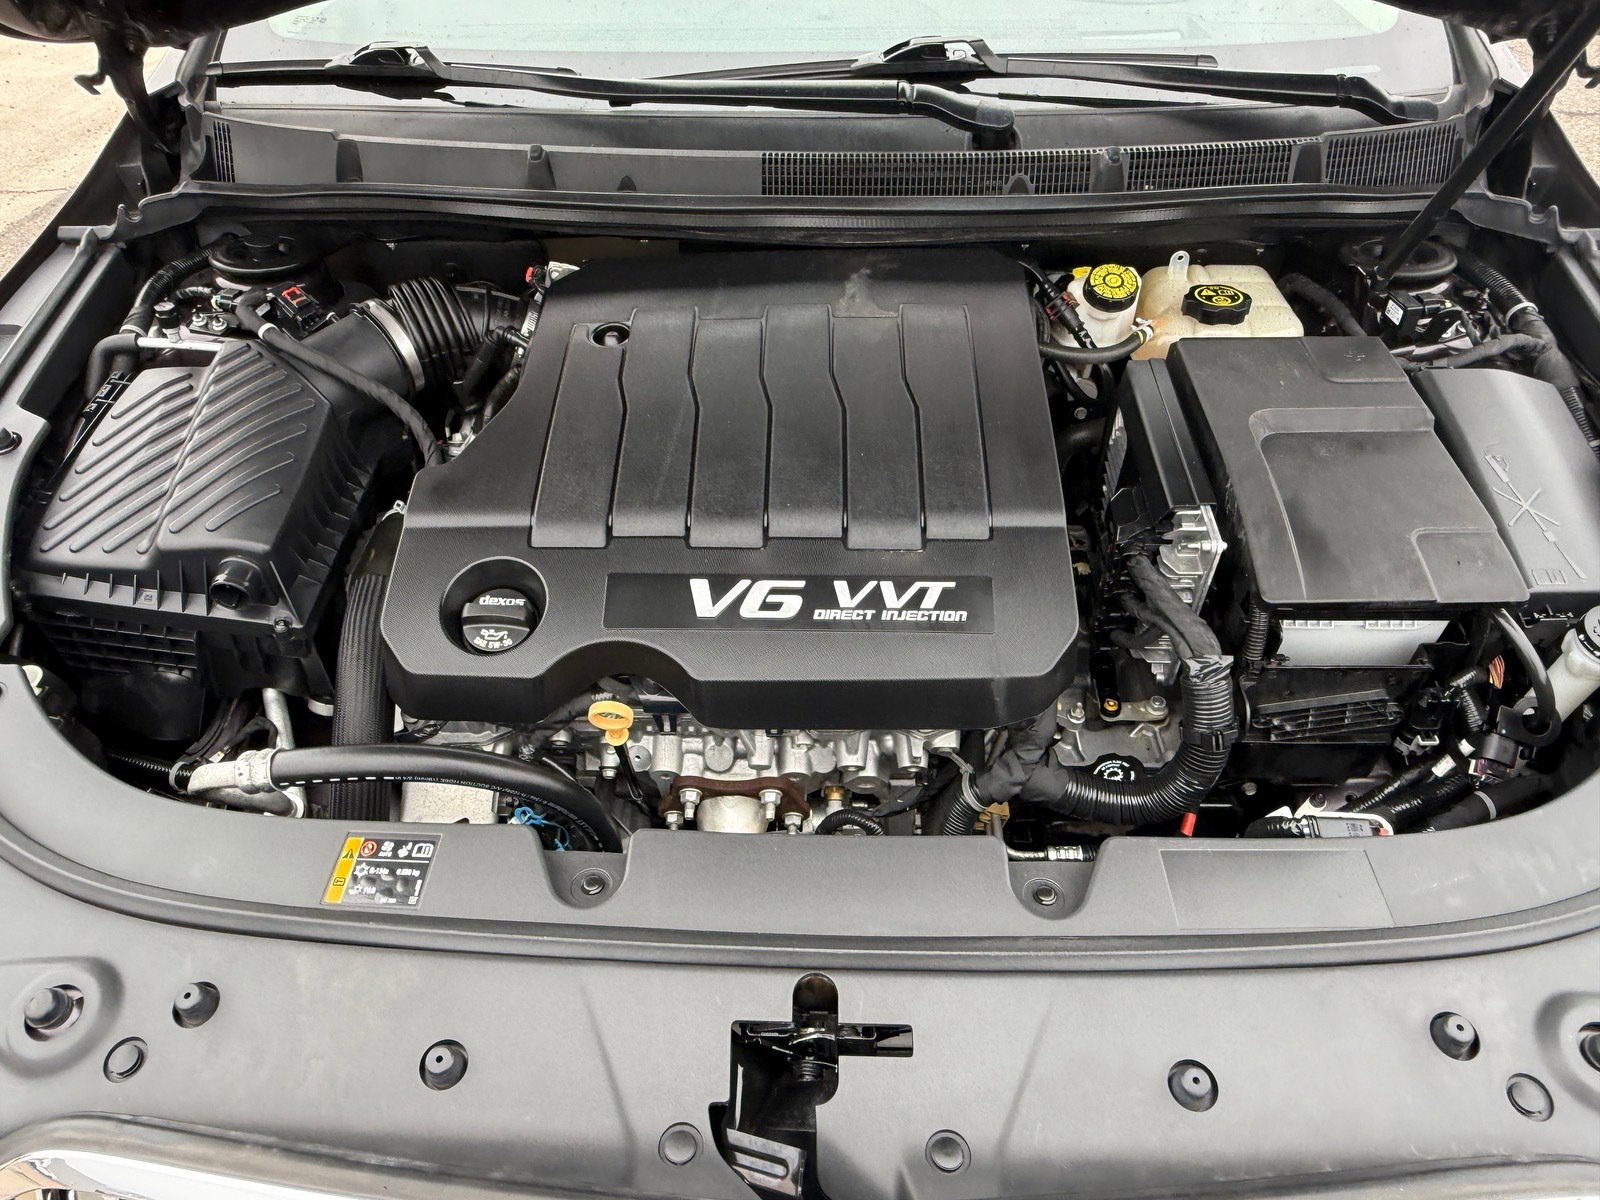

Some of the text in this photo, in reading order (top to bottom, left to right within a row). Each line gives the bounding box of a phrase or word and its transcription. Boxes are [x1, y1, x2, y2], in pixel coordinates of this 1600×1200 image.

[479, 595, 526, 606] dexos
[689, 578, 956, 619] V6 VVT
[813, 609, 968, 622] DIRECT INJECTION
